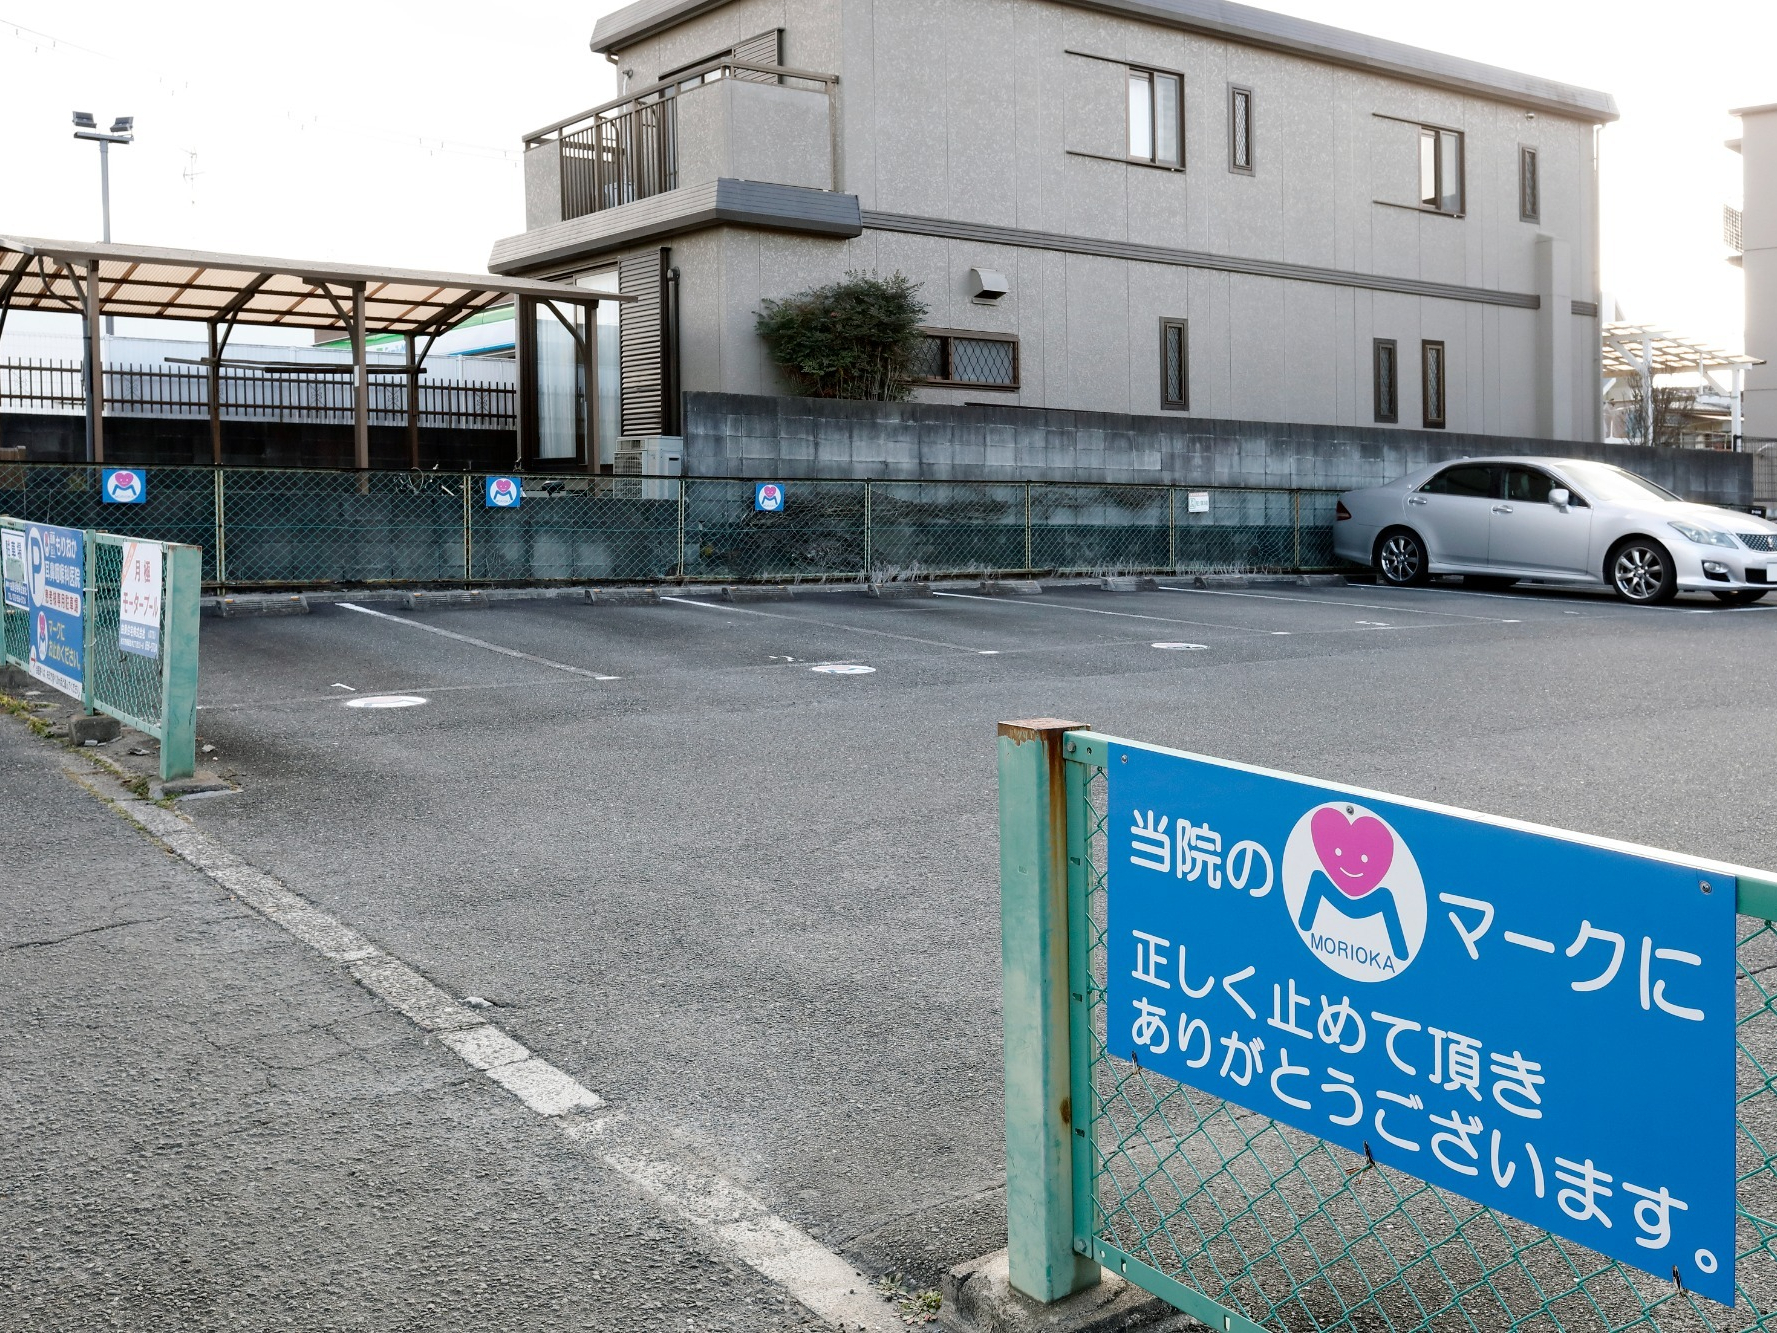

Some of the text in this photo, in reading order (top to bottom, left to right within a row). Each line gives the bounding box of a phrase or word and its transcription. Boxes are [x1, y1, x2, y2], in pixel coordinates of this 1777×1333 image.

[55, 535, 77, 559] もりおか
[134, 560, 151, 583] 月極
[122, 592, 159, 619] モータープール
[48, 620, 65, 641] マークに
[1130, 809, 1706, 1022] 当院の マークに
[1310, 932, 1396, 974] MORIOKA
[1130, 930, 1546, 1120] 正しく止めて頂き
[1131, 997, 1719, 1275] ありがとうございます。
